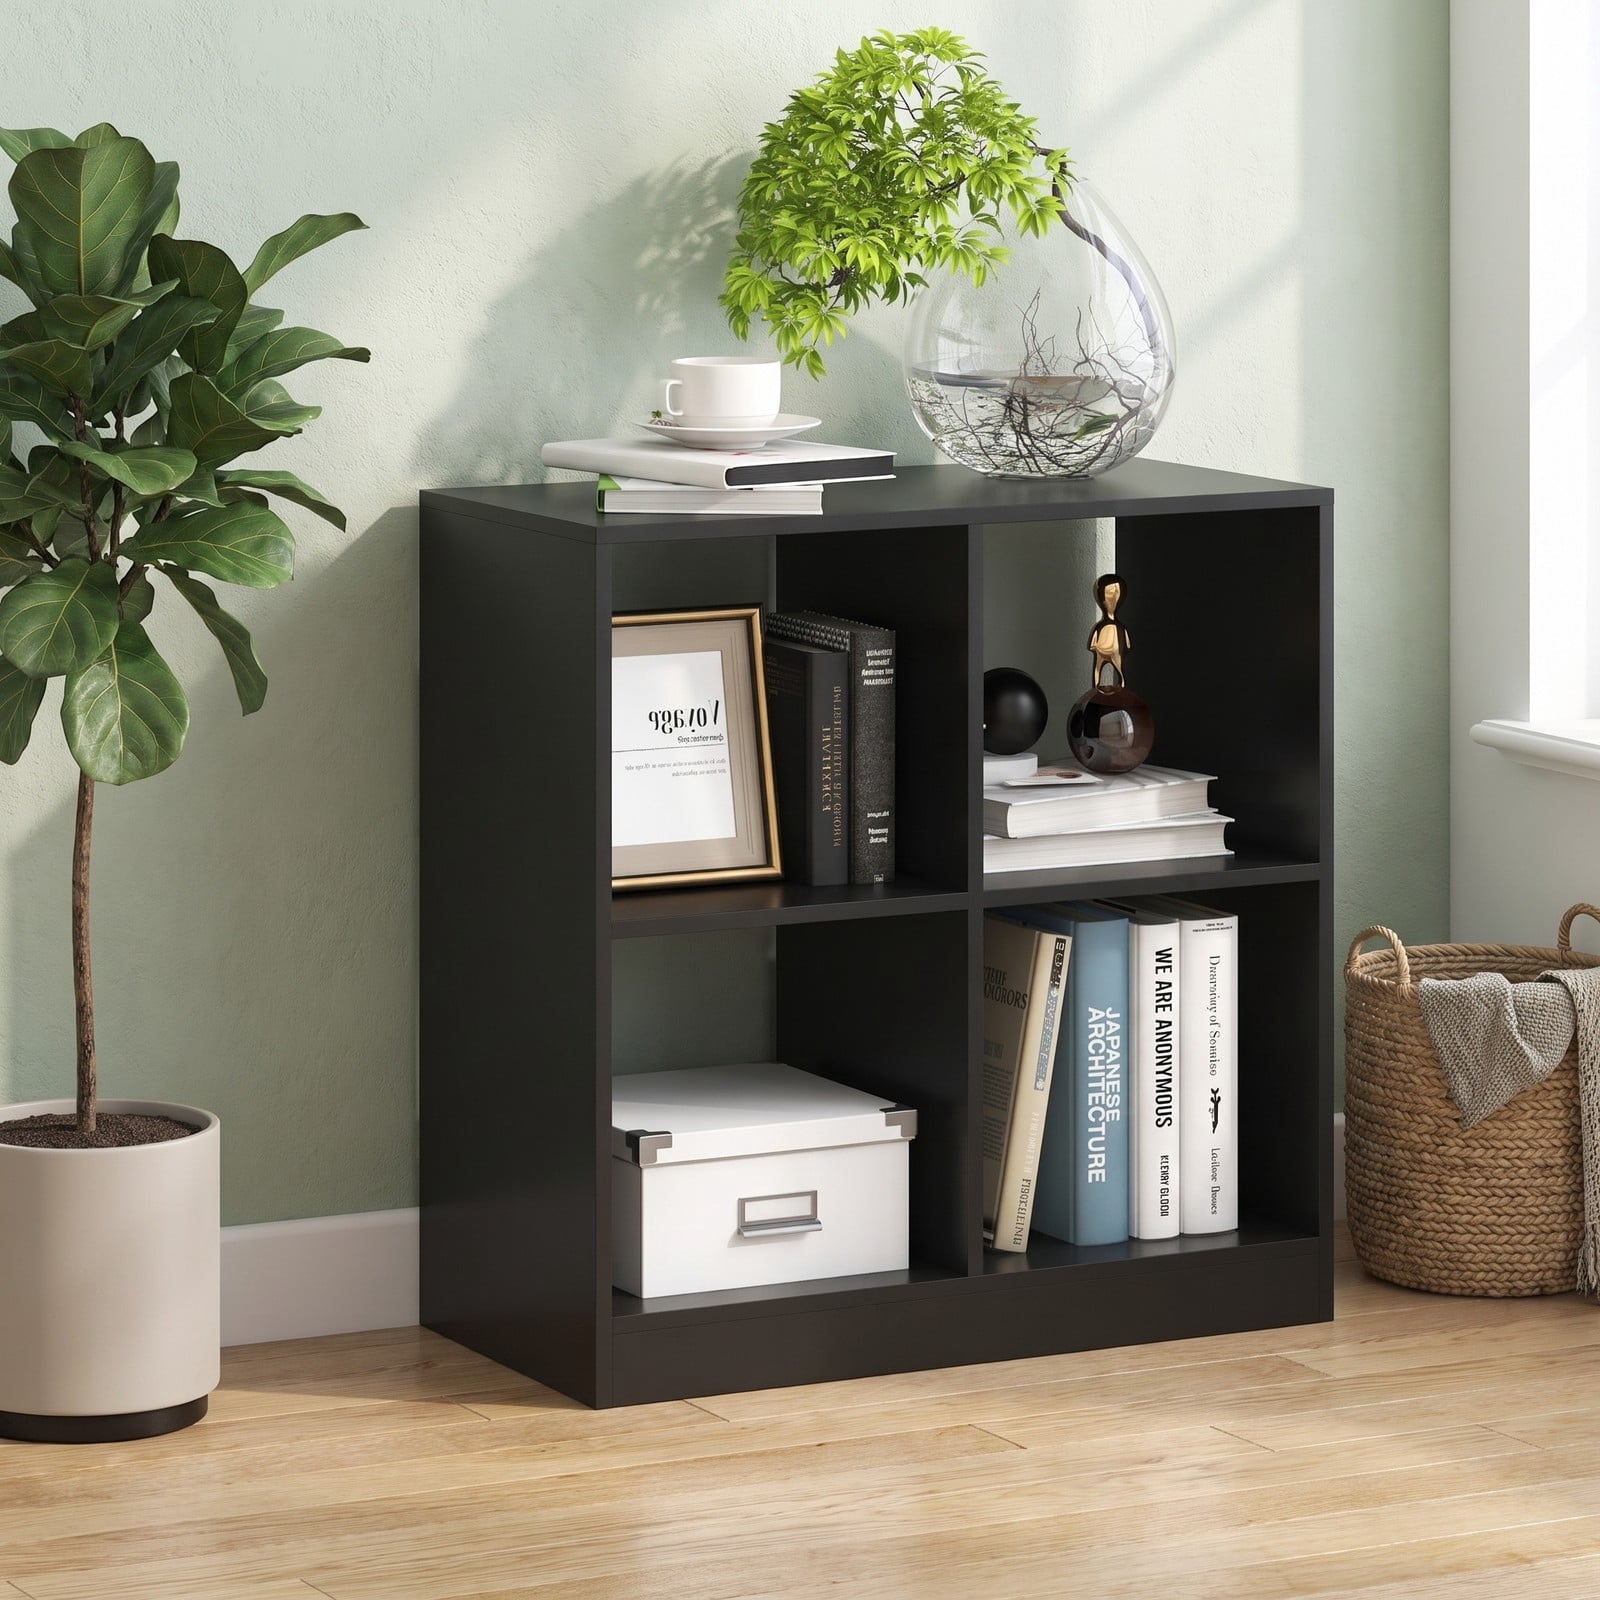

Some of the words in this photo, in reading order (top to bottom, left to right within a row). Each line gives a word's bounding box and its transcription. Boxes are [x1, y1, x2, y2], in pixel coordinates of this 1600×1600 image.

[1155, 947, 1173, 975] WE
[1155, 980, 1173, 1014] ARE
[1088, 1006, 1106, 1184] ARCHITECTURE
[1106, 1006, 1121, 1122] JAPANESE
[1155, 1019, 1173, 1128] ANONYMOUS
